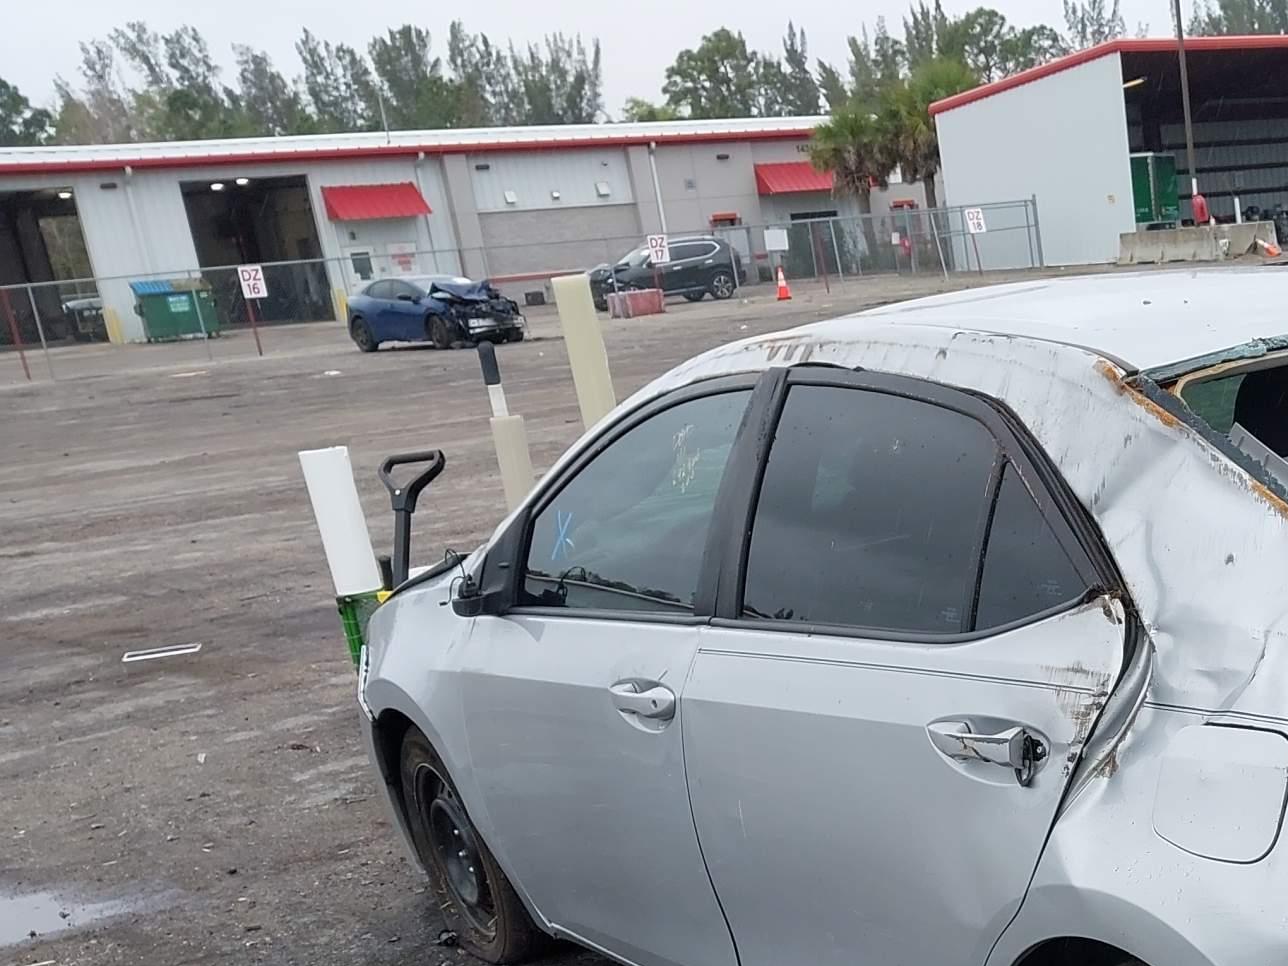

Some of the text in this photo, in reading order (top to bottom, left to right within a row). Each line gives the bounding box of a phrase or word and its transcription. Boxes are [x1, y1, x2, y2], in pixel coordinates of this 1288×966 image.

[967, 210, 982, 221] DZ
[650, 236, 665, 249] DZ
[655, 249, 664, 260] 17
[240, 268, 261, 281] DZ
[247, 282, 260, 295] 16
